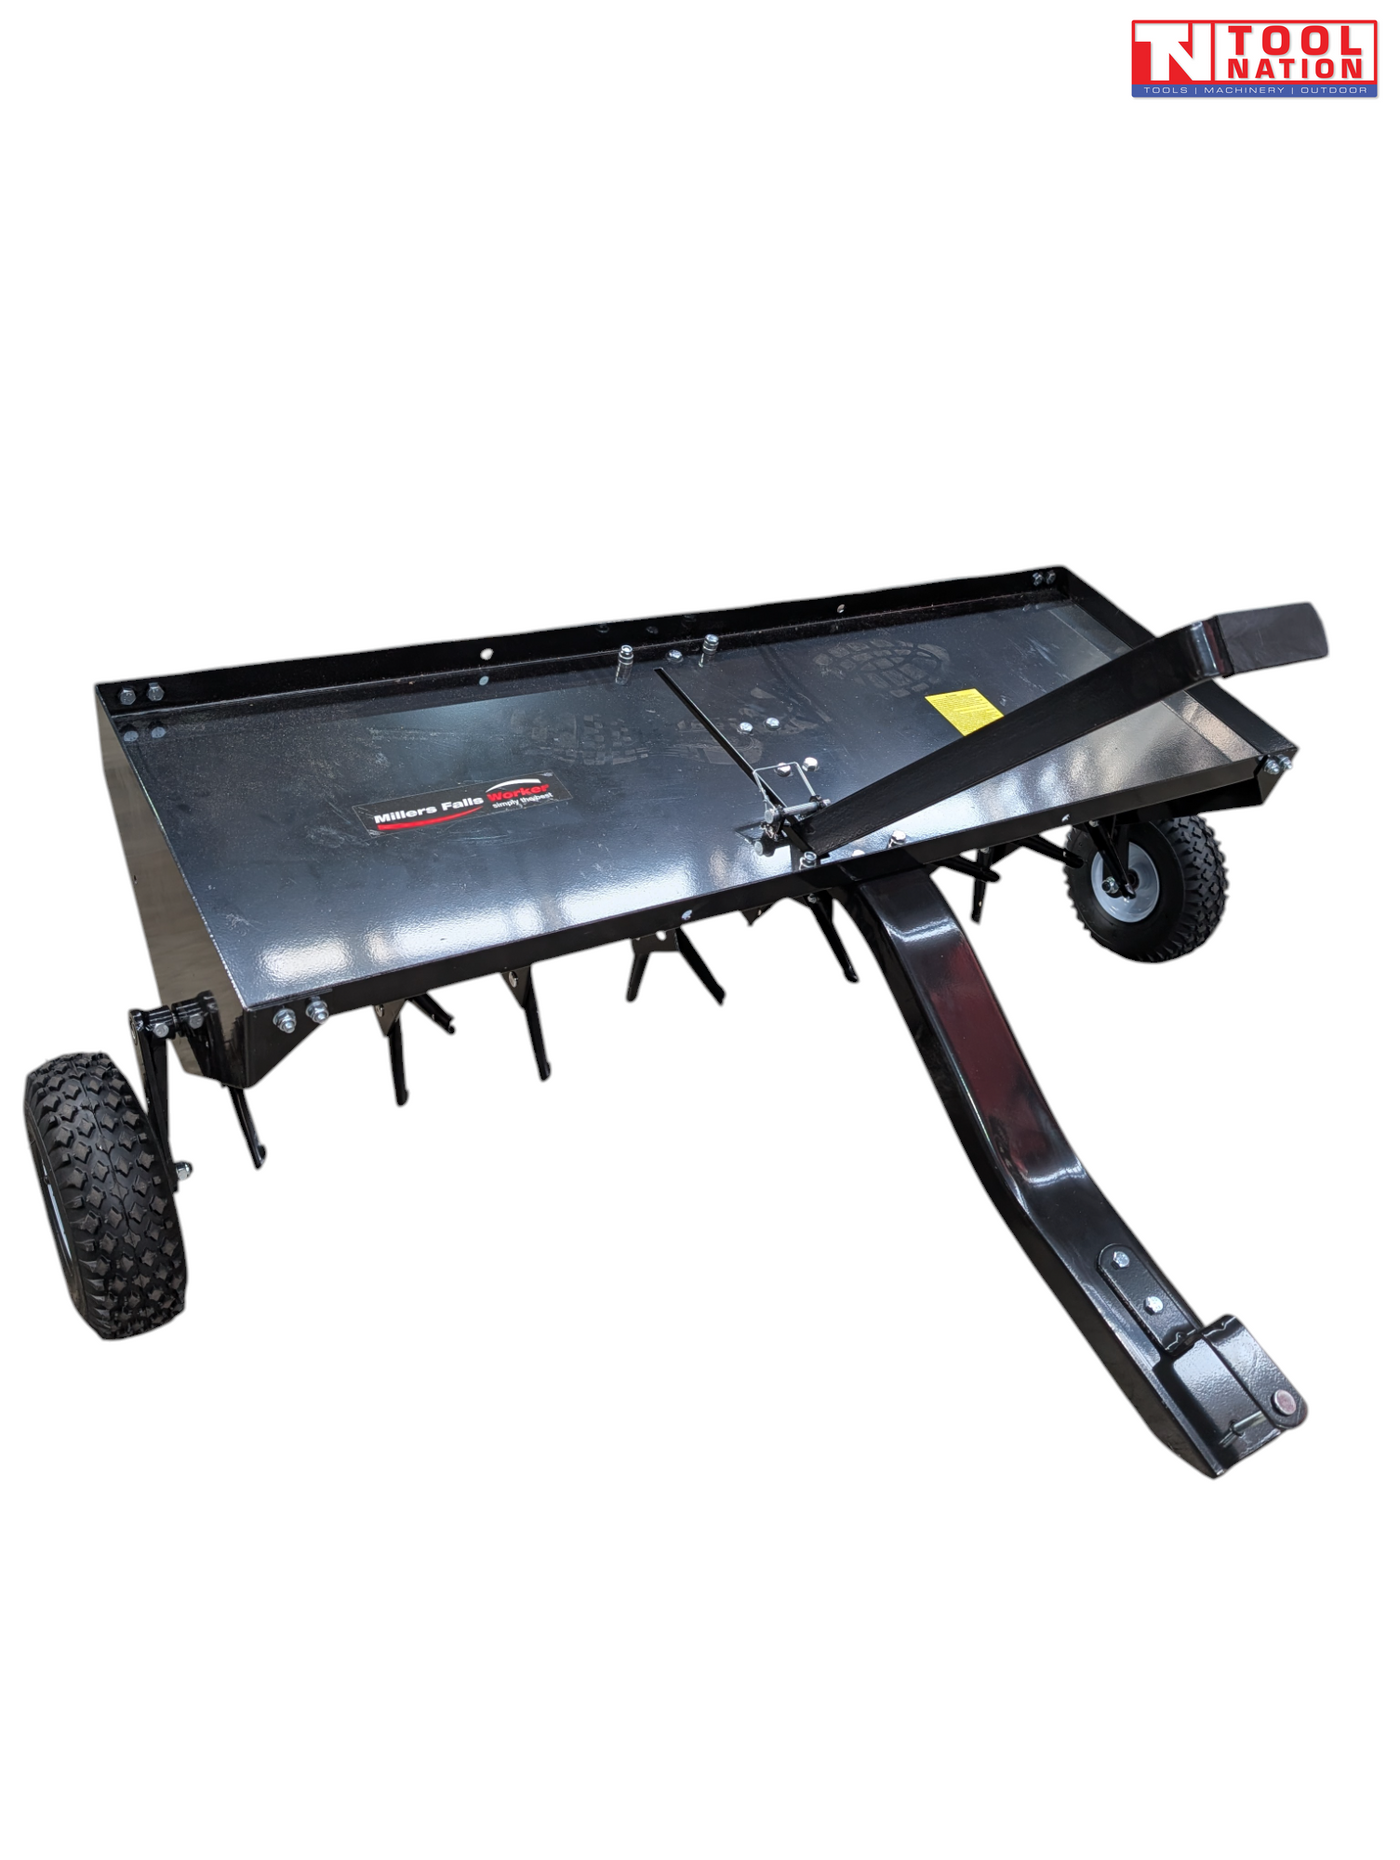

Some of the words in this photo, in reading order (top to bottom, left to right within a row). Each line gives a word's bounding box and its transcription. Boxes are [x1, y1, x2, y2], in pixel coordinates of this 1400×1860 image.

[374, 804, 438, 824] Millers
[441, 796, 484, 812] Falls
[486, 783, 550, 802] Worker
[492, 799, 519, 808] simply
